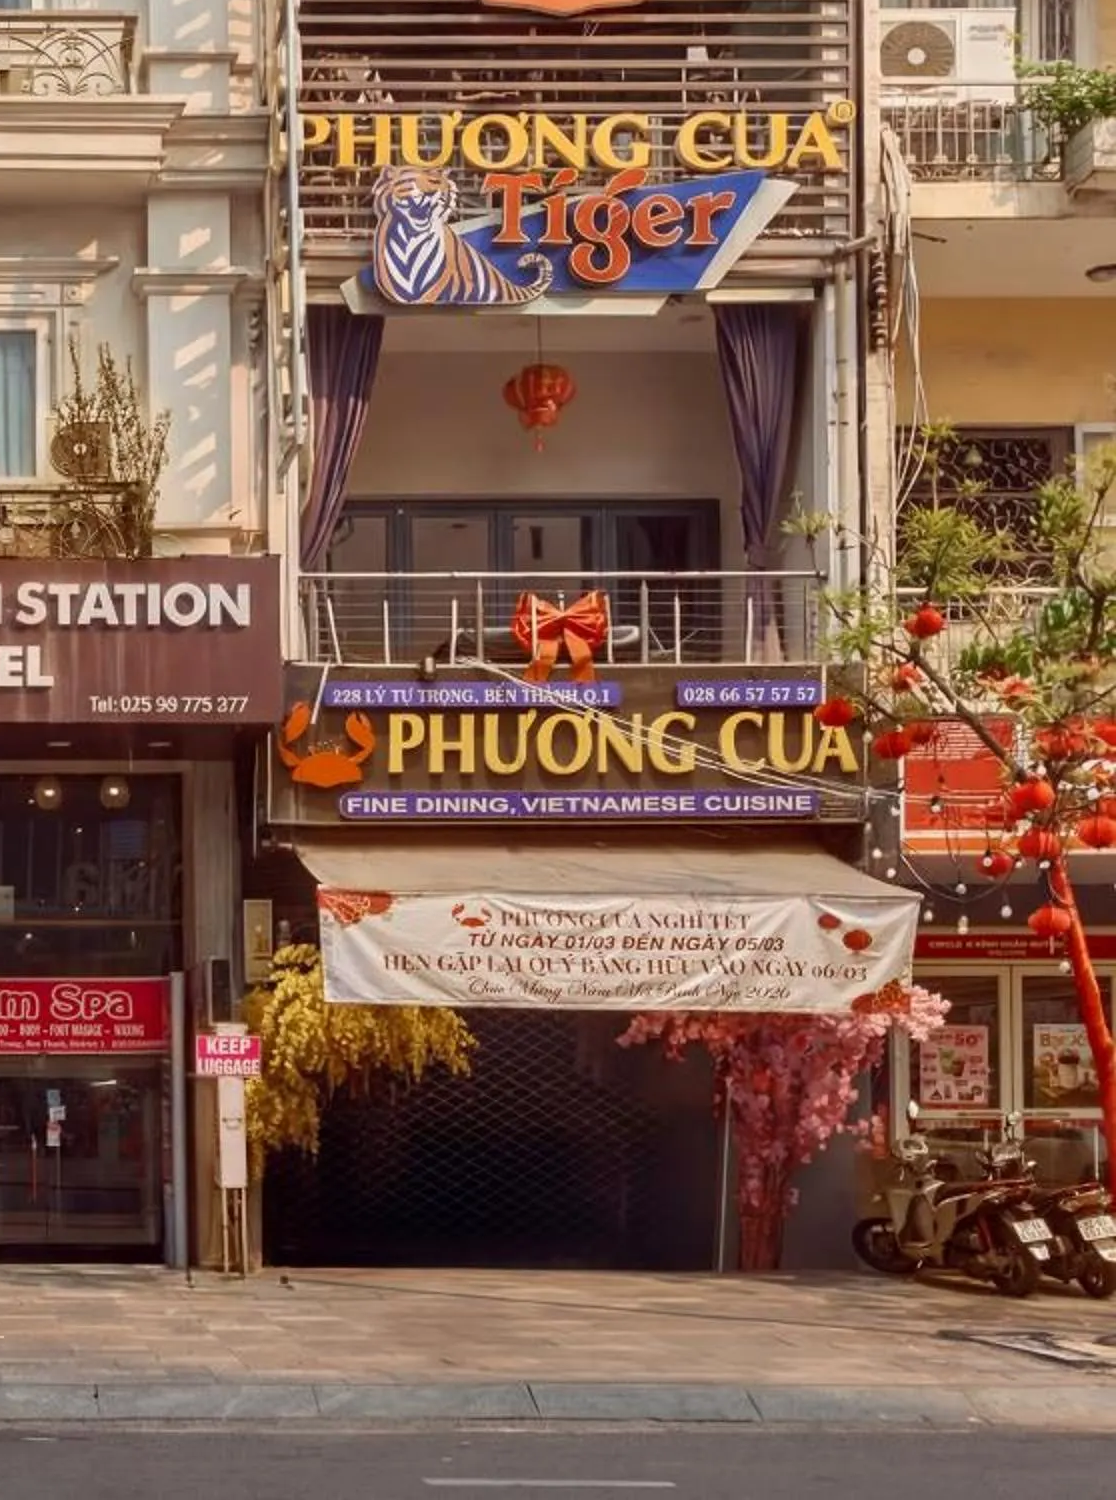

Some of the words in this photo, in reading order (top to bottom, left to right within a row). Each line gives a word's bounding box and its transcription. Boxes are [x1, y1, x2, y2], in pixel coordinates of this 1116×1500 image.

[676, 110, 848, 169] CUA
[484, 167, 736, 284] Tiger
[16, 581, 250, 627] STATION
[181, 696, 213, 713] 775
[333, 688, 361, 703] 228
[364, 684, 386, 703] LÝ
[391, 687, 413, 707] TỰ
[484, 682, 517, 703] BẾN
[683, 687, 715, 702] 028
[719, 687, 741, 702] 66
[745, 687, 765, 702] 57
[771, 687, 791, 701] 57
[796, 687, 816, 701] 57
[387, 708, 697, 776] PHƯƠNG
[719, 710, 859, 774] CUA
[347, 797, 408, 814] FINE
[416, 797, 516, 817] DINING,
[520, 795, 696, 813] VIETNAMESE
[703, 794, 813, 813] CUISINE
[500, 931, 560, 949] NGÀY
[565, 935, 616, 950] 01/03
[671, 933, 730, 951] NGÀY
[735, 936, 784, 951] 05/03
[50, 983, 133, 1021] Spa
[206, 1036, 252, 1055] KEEP
[196, 1058, 261, 1076] LUGGAGE
